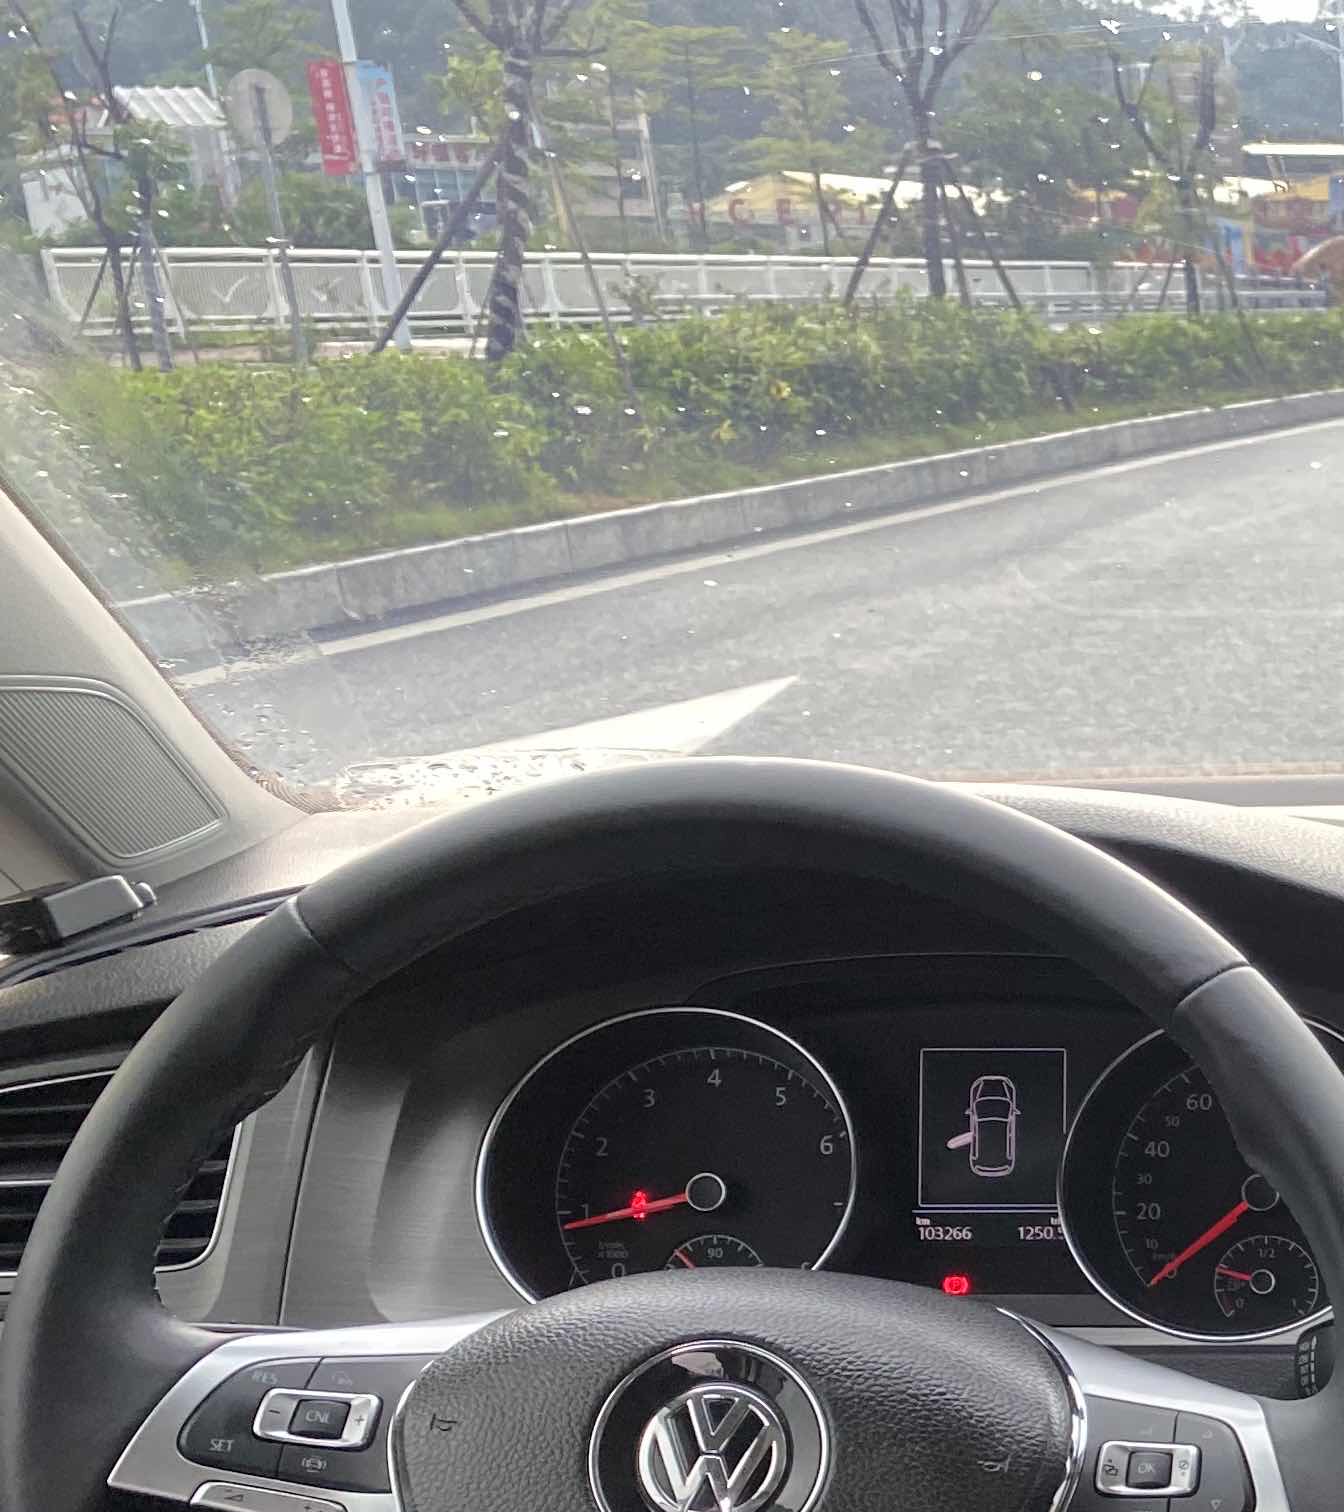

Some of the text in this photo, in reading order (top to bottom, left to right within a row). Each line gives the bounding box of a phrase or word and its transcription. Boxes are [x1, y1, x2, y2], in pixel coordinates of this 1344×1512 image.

[707, 1069, 721, 1087] 4
[643, 1089, 656, 1108] 3
[775, 1087, 787, 1106] 5
[1186, 1094, 1212, 1110] 60
[1165, 1116, 1180, 1127] 50
[596, 1137, 608, 1156] 2
[820, 1135, 833, 1155] 6
[1144, 1141, 1170, 1158] 40
[1136, 1174, 1152, 1184] 30
[580, 1204, 590, 1219] 1
[1136, 1203, 1161, 1220] 20
[915, 1216, 931, 1225] km
[918, 1226, 972, 1240] 103266
[1145, 1239, 1159, 1248] 10
[707, 1248, 723, 1258] 90
[1258, 1248, 1275, 1258] 1/2
[611, 1262, 626, 1278] 0
[252, 1370, 278, 1385] RES
[210, 1438, 235, 1452] SET
[1137, 1462, 1156, 1474] OK
